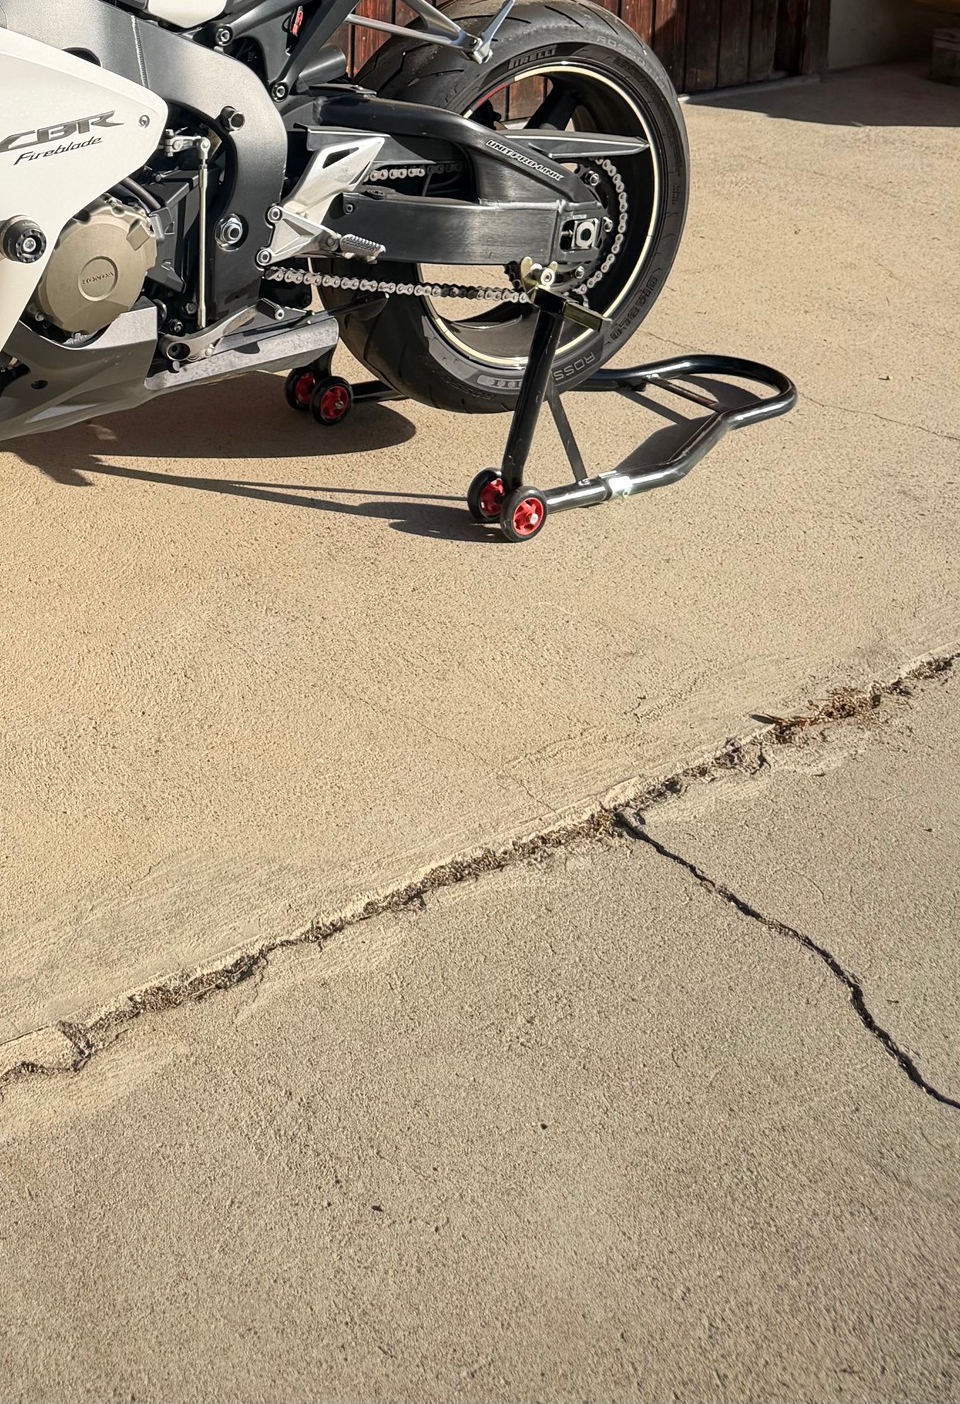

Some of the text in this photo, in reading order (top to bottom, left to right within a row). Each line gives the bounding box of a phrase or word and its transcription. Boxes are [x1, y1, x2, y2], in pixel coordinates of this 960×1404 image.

[507, 45, 558, 71] PIRELLI
[13, 136, 103, 166] Fireblade
[485, 139, 513, 157] UNIT
[552, 351, 597, 381] ROSS
